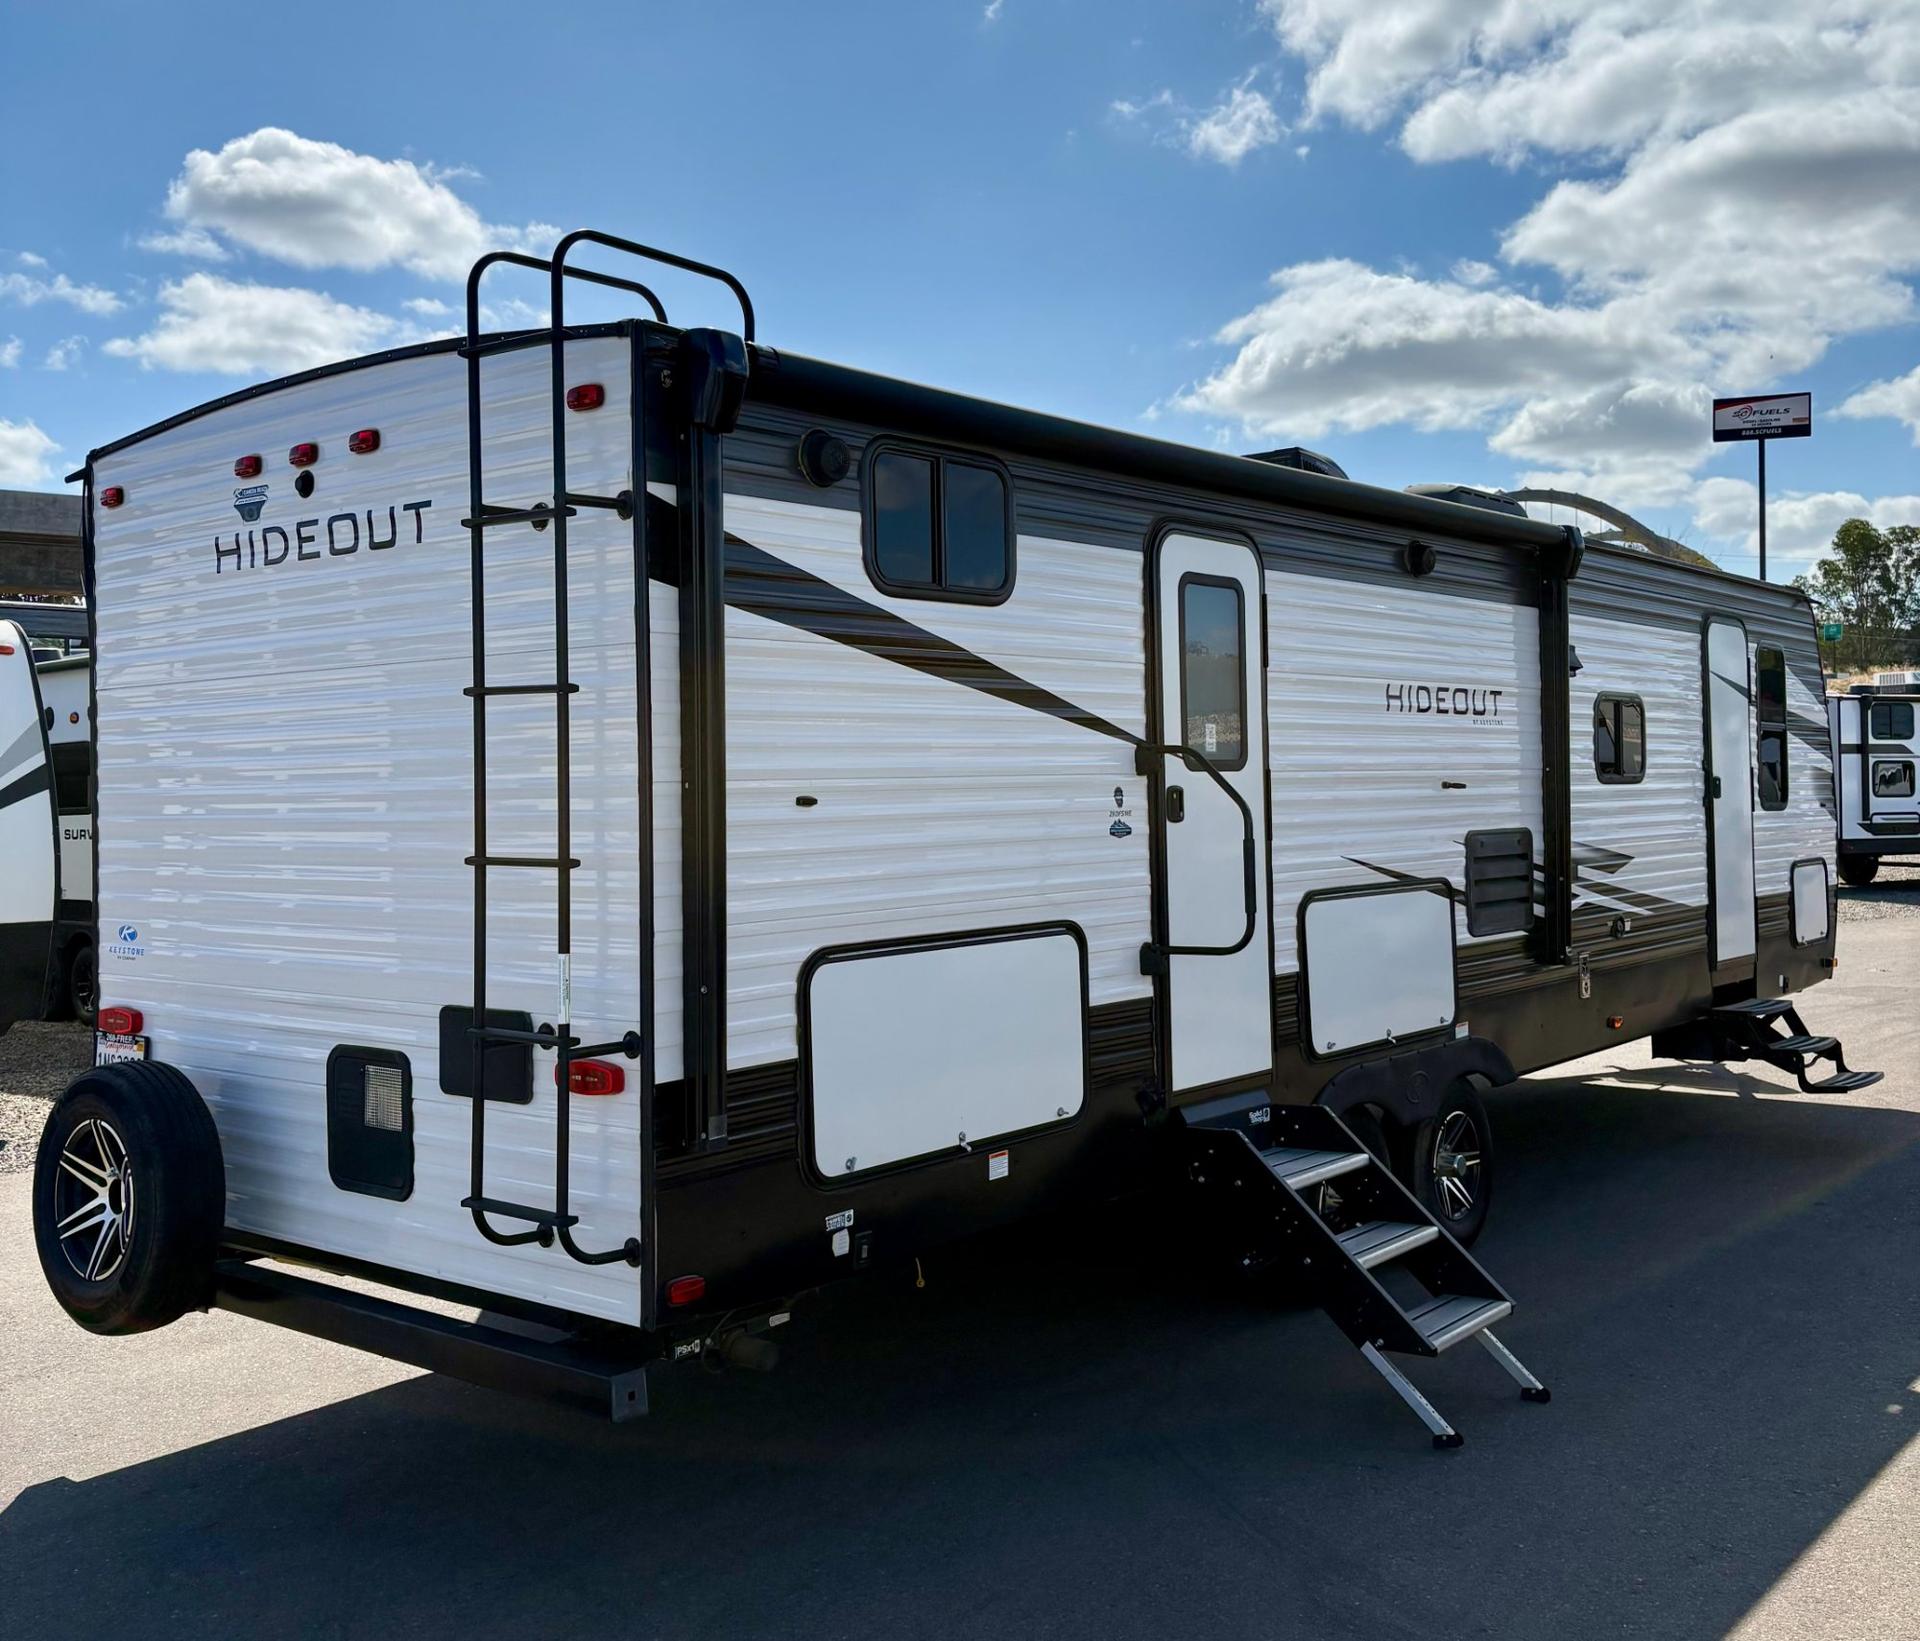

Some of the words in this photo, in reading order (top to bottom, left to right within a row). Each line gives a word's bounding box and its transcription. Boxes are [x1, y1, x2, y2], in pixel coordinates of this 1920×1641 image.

[1752, 407, 1791, 417] FUELS
[214, 499, 433, 574] HIDEOUT
[1385, 683, 1502, 717] HIDEOUT
[108, 945, 145, 957] KEYSTONE
